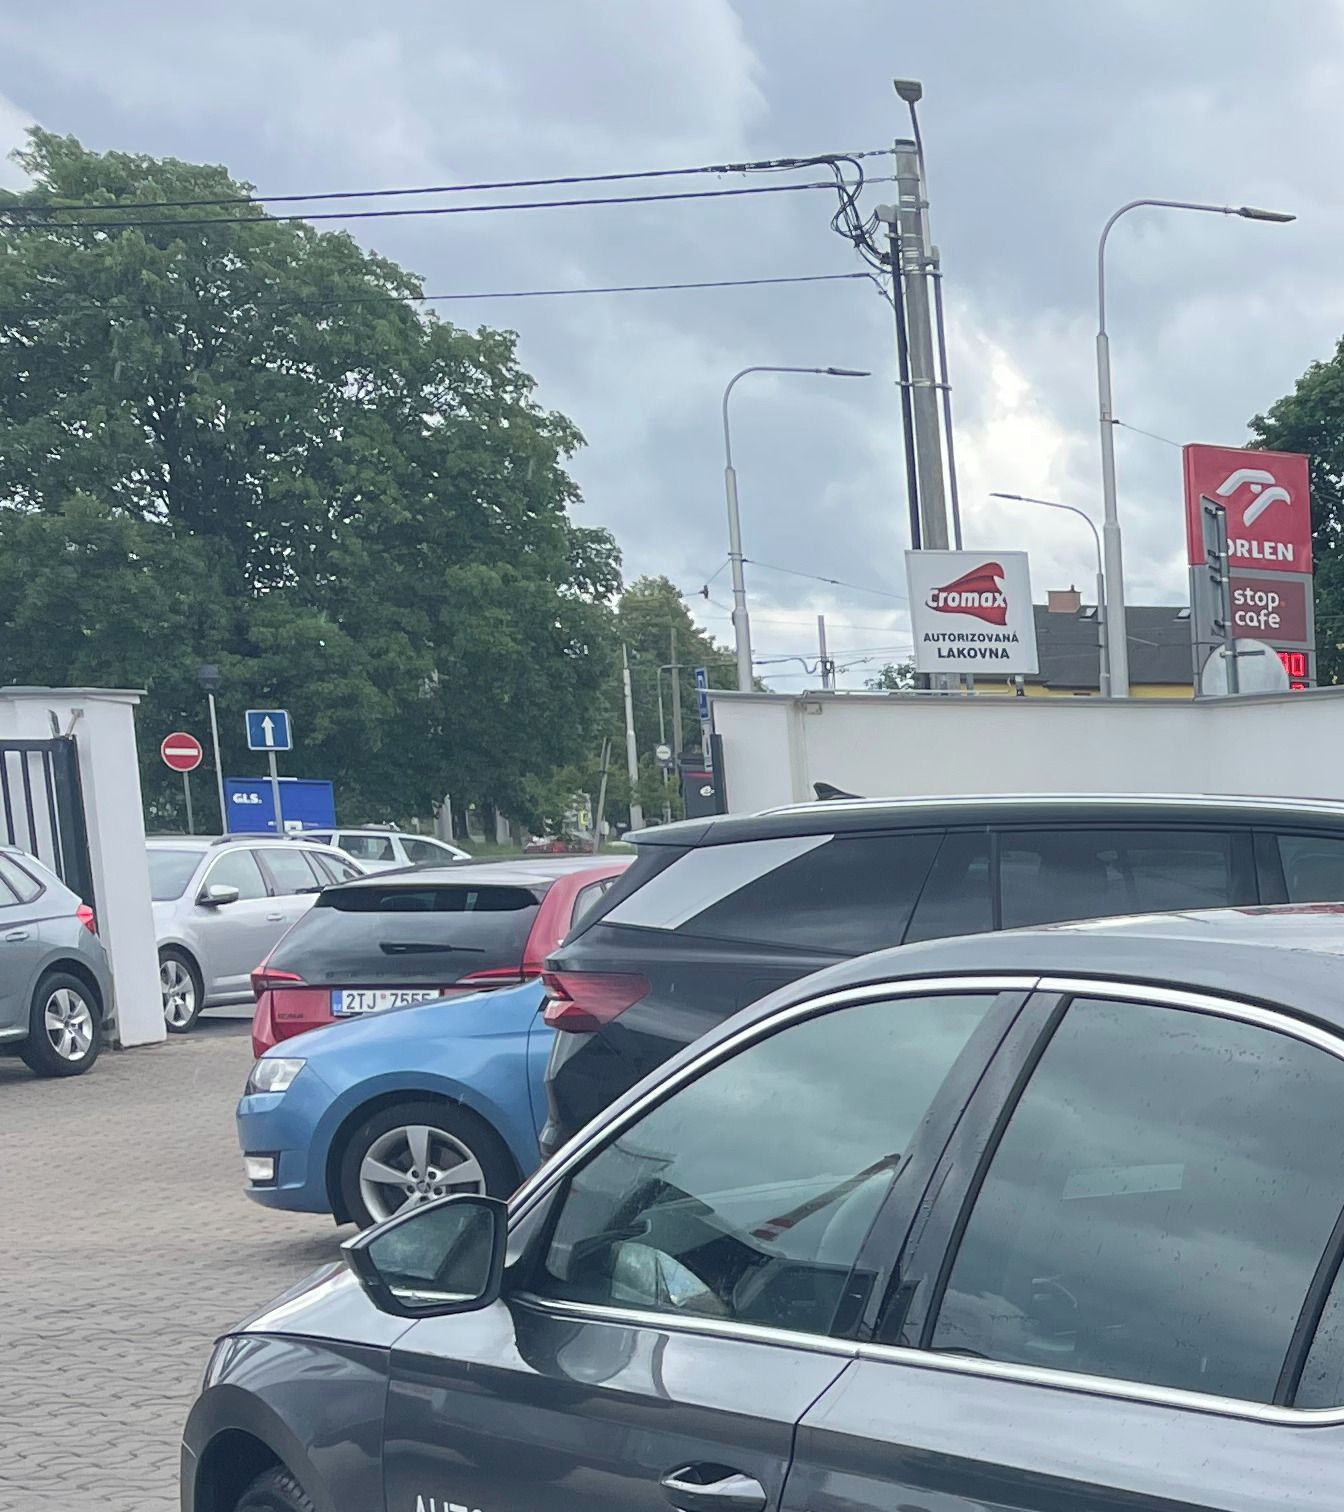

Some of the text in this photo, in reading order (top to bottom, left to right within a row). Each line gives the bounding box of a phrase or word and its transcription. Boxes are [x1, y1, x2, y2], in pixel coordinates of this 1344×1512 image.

[1235, 608, 1281, 630] cafe
[924, 631, 1019, 643] AUTORIZOVANÁ
[937, 647, 1010, 659] LAKOVNA
[346, 993, 376, 1010] 2TJ
